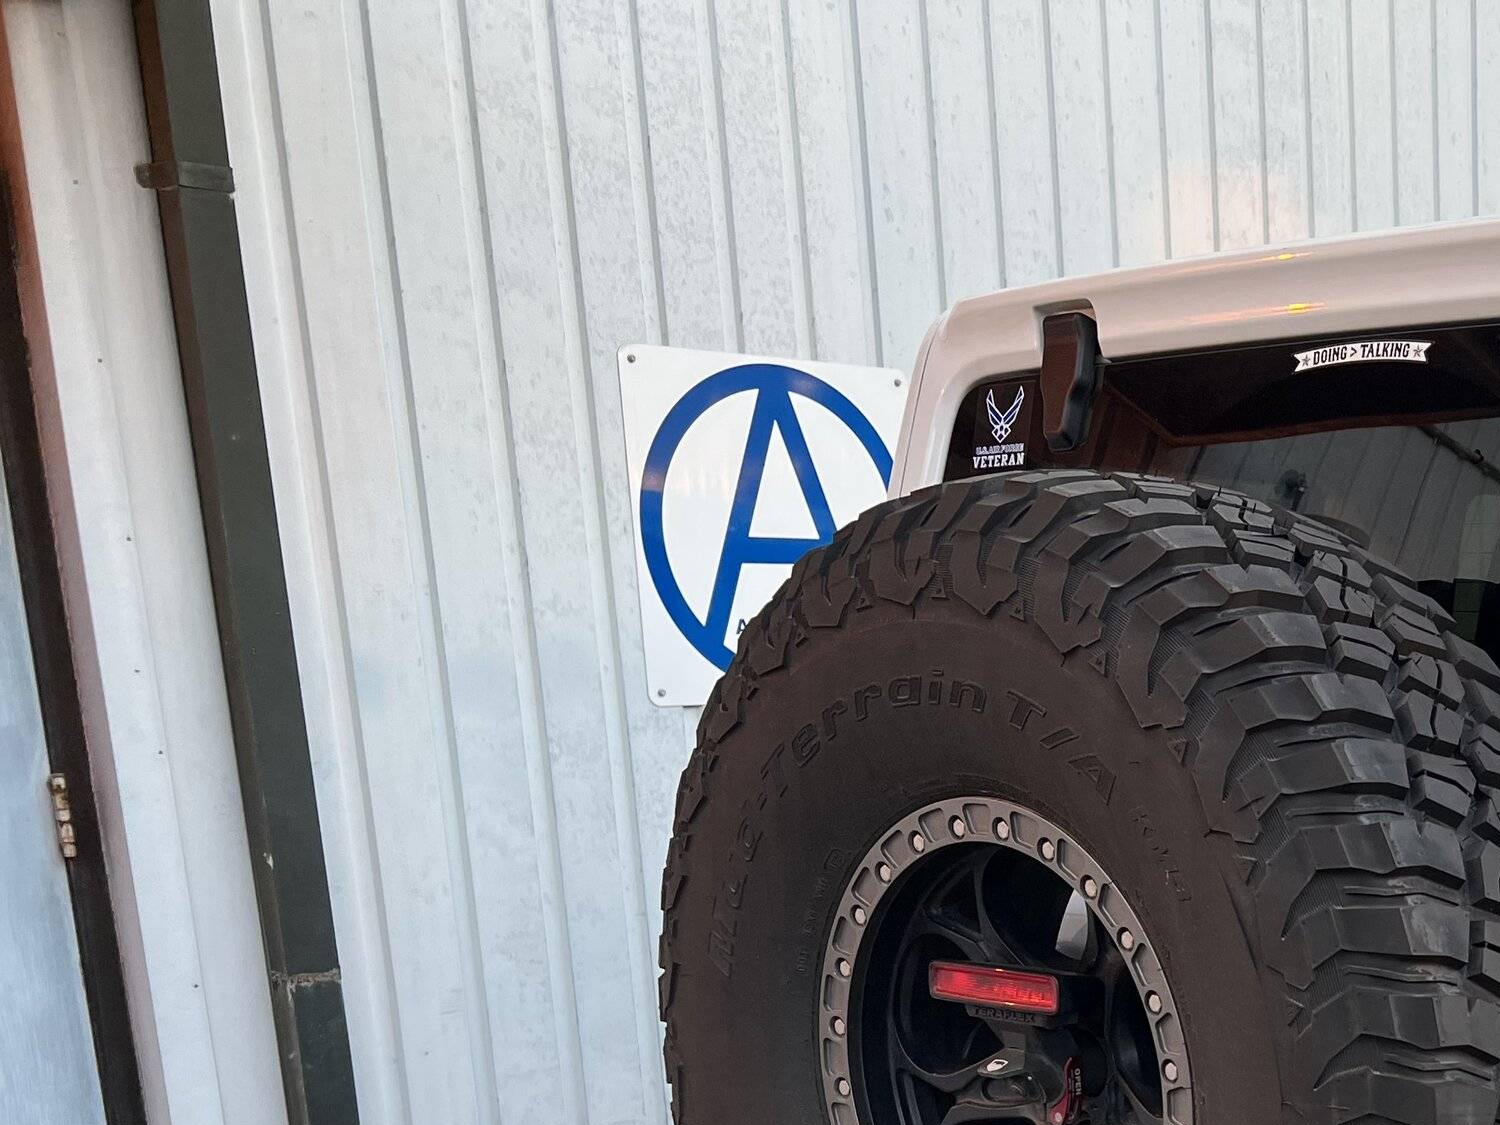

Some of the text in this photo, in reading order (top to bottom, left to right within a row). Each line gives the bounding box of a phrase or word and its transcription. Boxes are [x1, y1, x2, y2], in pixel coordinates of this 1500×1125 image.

[1313, 346, 1347, 365] DOING
[1360, 342, 1410, 358] TALKING
[973, 452, 1025, 469] VETERAN
[974, 1006, 1035, 1023] TERAFLEX
[1073, 1068, 1082, 1096] OPEN
